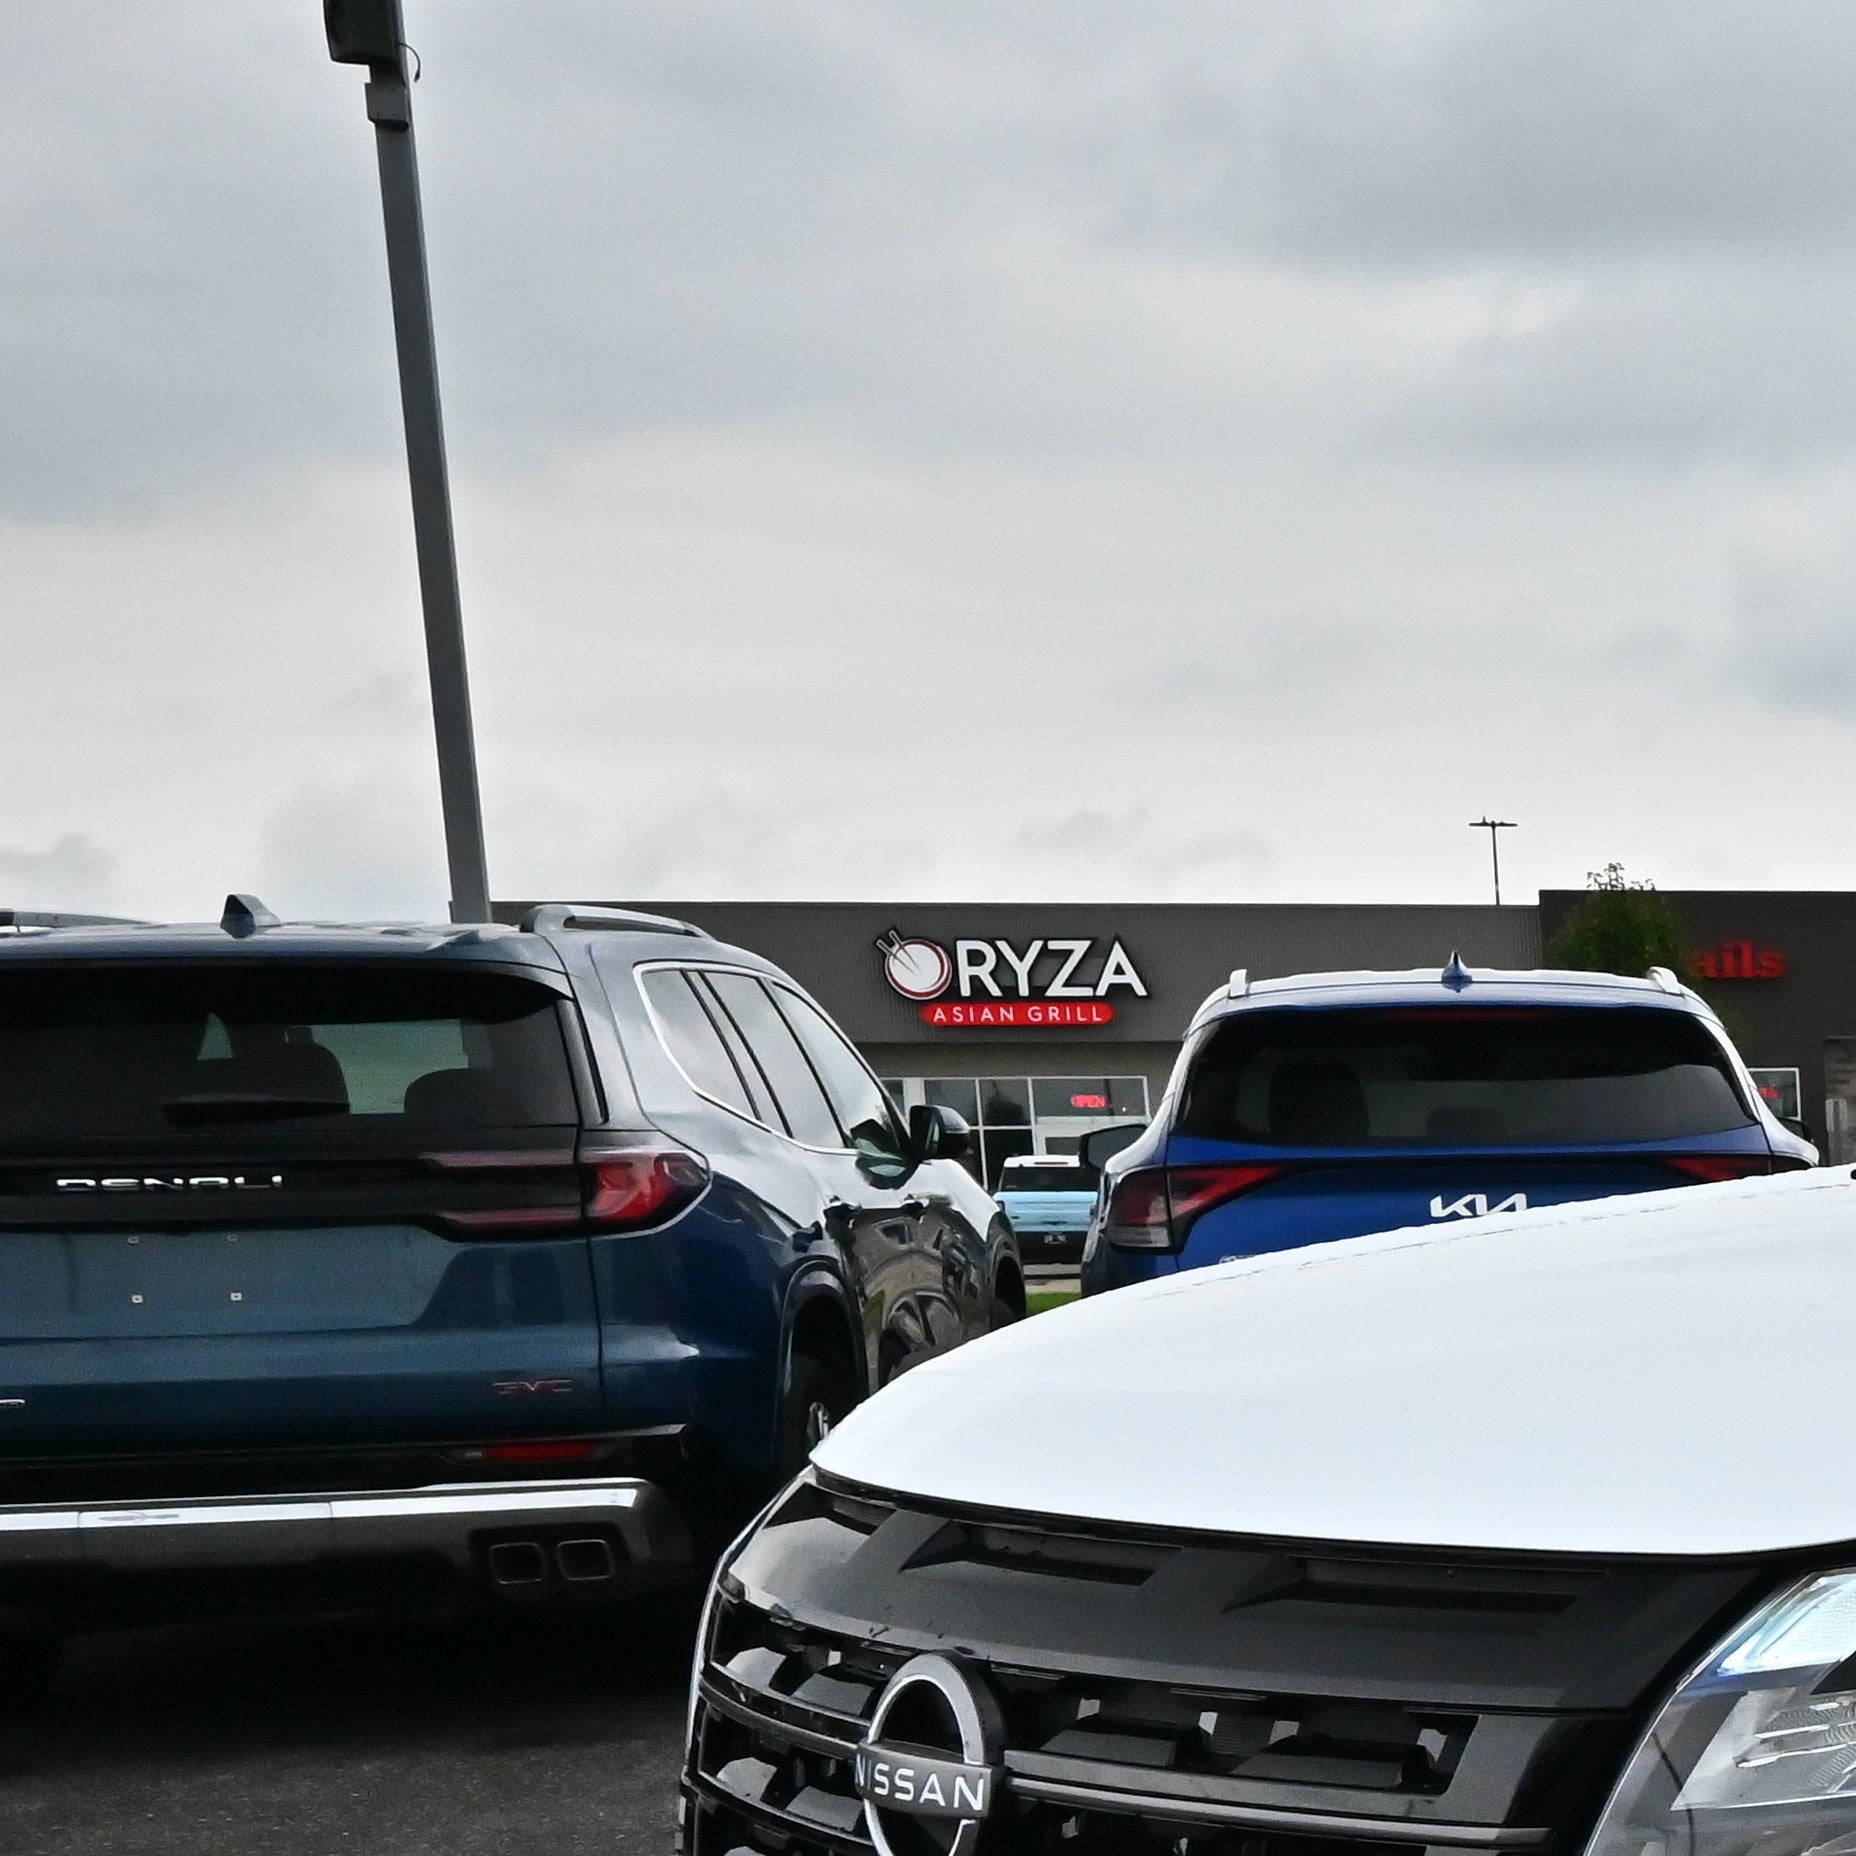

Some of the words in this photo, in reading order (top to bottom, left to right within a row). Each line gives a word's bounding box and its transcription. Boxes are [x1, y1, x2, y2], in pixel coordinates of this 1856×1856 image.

[884, 938, 1149, 1000] ORYZA
[1689, 939, 1787, 979] ails
[932, 1006, 1015, 1023] ASIAN
[1027, 1006, 1103, 1023] GRILL
[55, 1173, 284, 1193] DENALI
[1430, 1192, 1528, 1218] KIA
[491, 1378, 573, 1395] GMC
[854, 1752, 984, 1812] NISSAN
